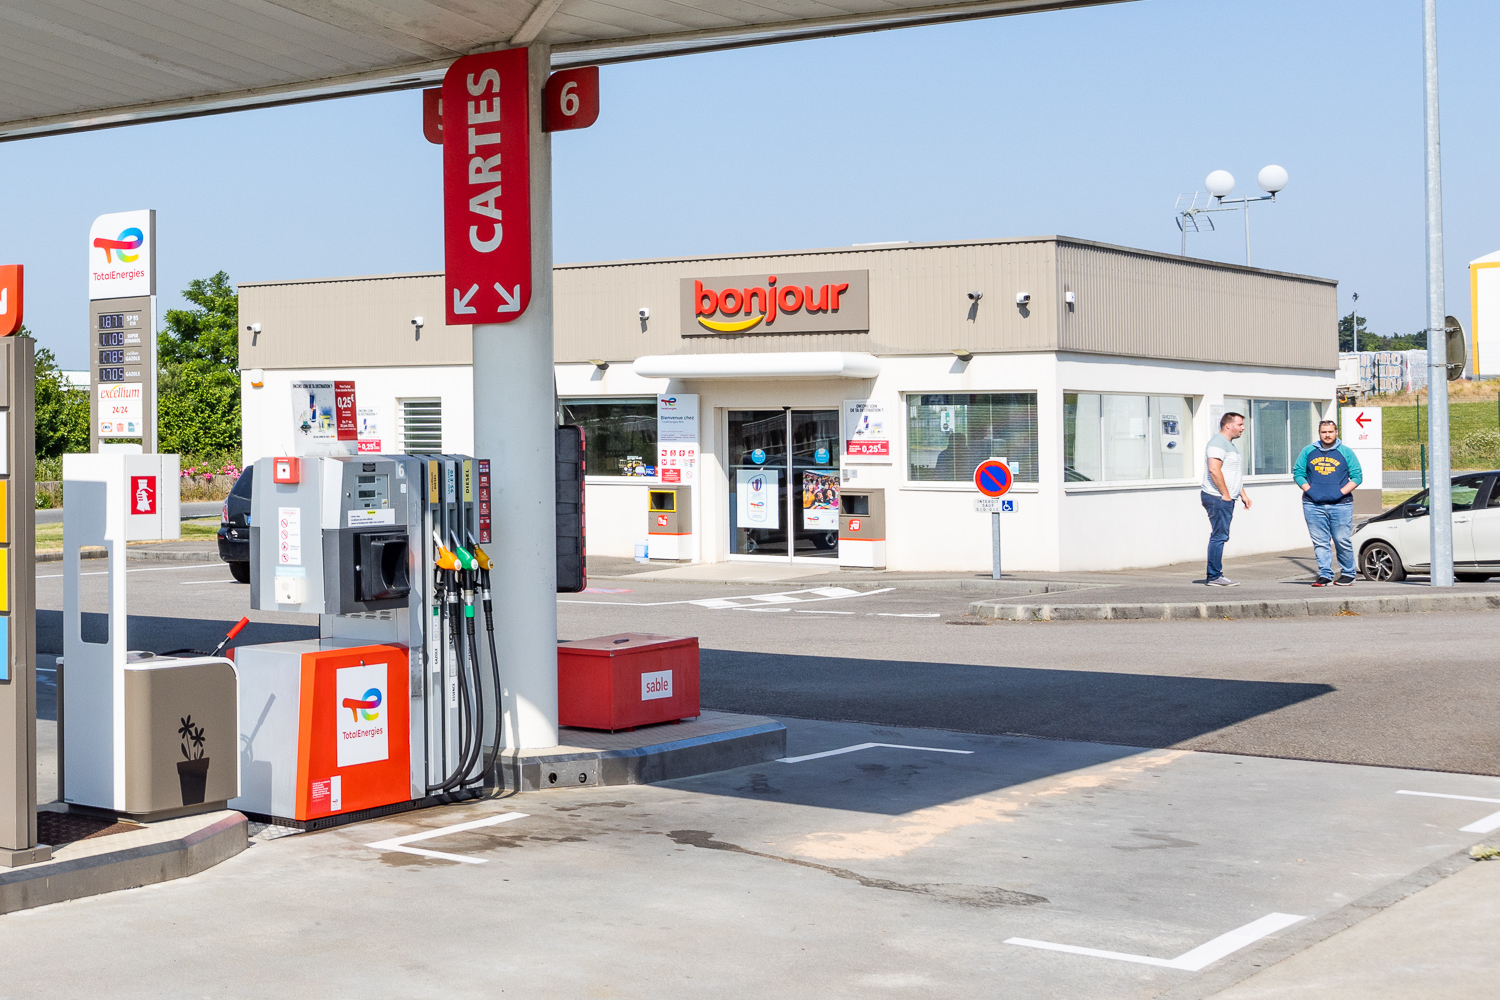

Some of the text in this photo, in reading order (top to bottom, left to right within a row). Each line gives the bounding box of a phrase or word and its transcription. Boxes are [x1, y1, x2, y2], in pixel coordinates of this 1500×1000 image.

[560, 81, 580, 116] 6
[466, 68, 503, 253] CARTES
[93, 269, 145, 281] TotalEnergies
[694, 275, 849, 323] bonjour
[100, 386, 140, 399] excellium
[337, 394, 354, 410] 0,25€
[1358, 432, 1369, 440] air
[861, 443, 882, 454] 0,25€
[398, 463, 405, 477] 6
[646, 676, 669, 694] sable
[342, 727, 383, 740] TotalEnergies
